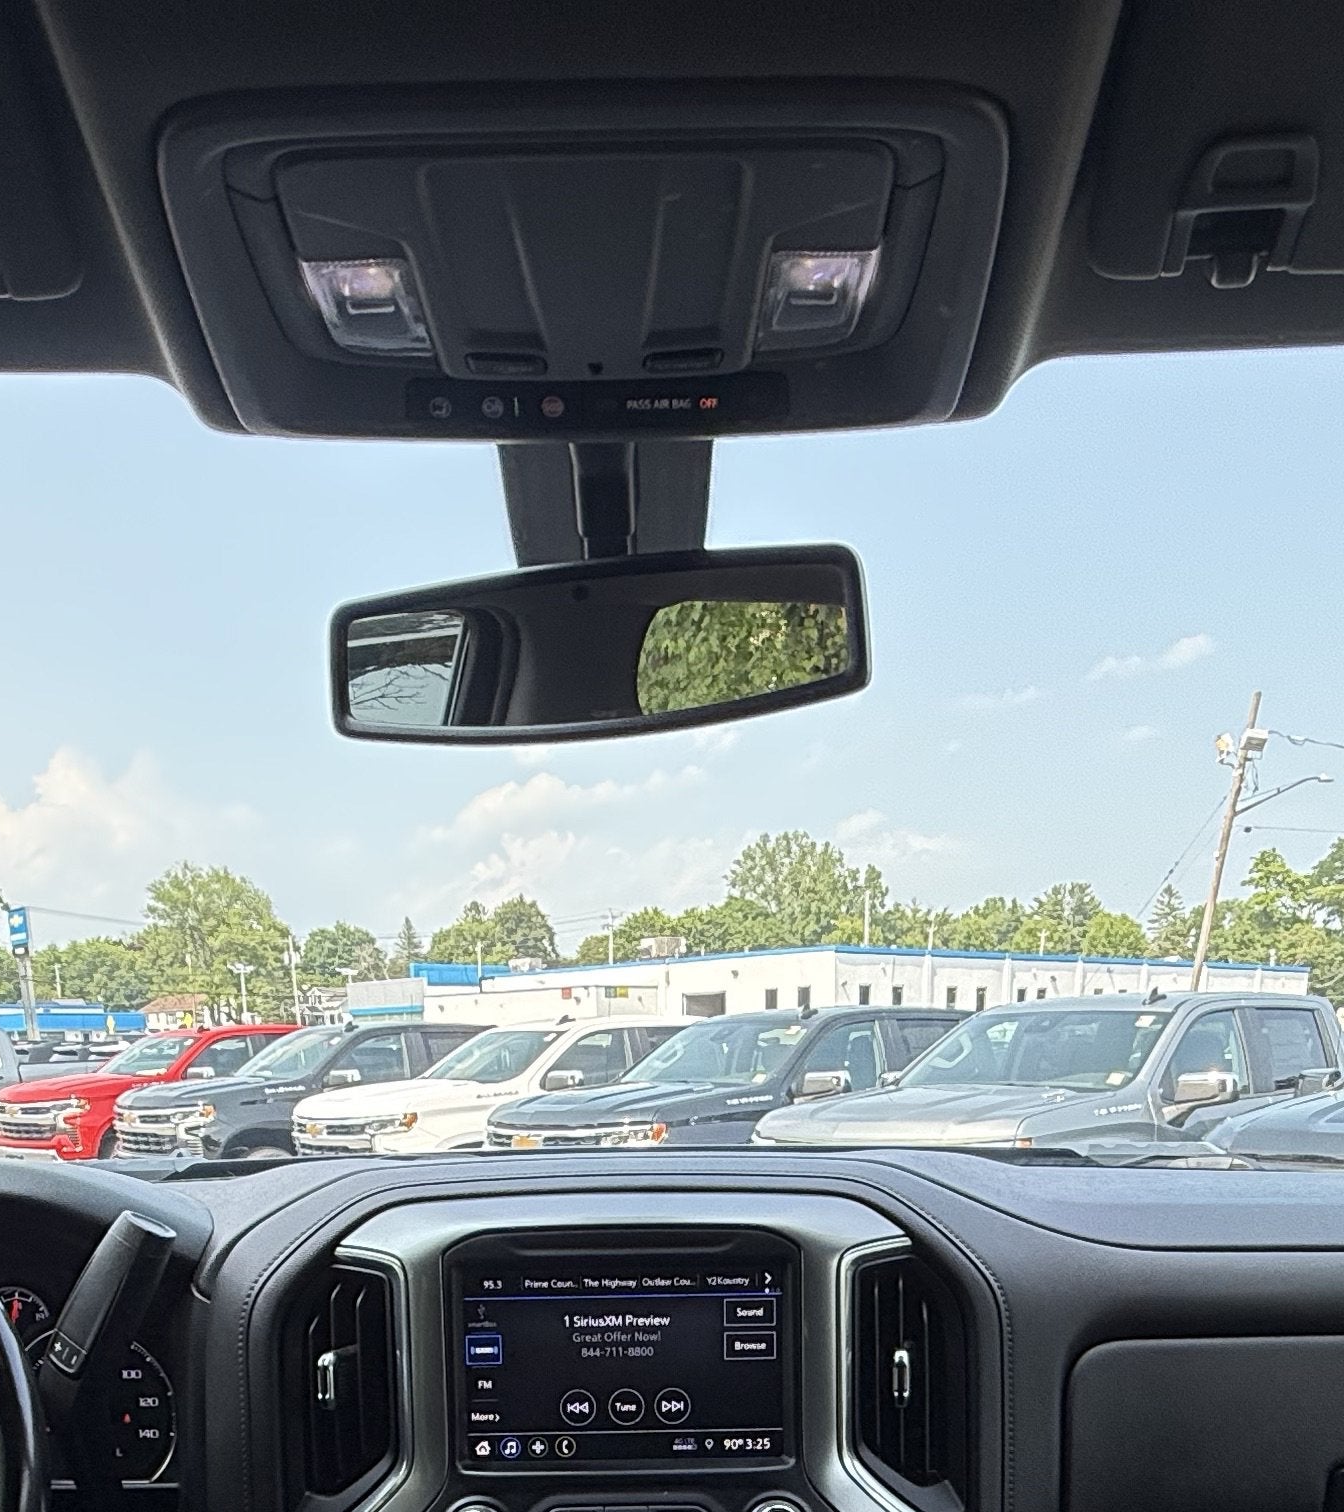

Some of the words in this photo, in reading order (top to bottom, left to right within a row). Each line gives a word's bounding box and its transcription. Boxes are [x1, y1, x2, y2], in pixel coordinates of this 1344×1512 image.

[626, 399, 651, 410] PASS
[653, 399, 670, 410] AIR
[671, 399, 691, 410] BAG
[700, 397, 718, 409] OFF
[483, 1280, 503, 1290] 95.3
[524, 1279, 549, 1289] Prime
[583, 1278, 600, 1288] The
[602, 1278, 637, 1290] Highway
[736, 1307, 764, 1318] Sound
[564, 1315, 570, 1328] 1
[573, 1314, 623, 1328] SiriusXM
[625, 1313, 671, 1327] Preview
[572, 1332, 602, 1343] Great
[604, 1331, 631, 1342] Offer
[634, 1330, 661, 1342] Now!
[734, 1341, 767, 1351] Browse
[581, 1346, 654, 1358] 844-711-8800
[121, 1369, 142, 1379] 100
[478, 1380, 492, 1389] FM
[139, 1397, 159, 1407] 120
[615, 1402, 637, 1412] Tune
[471, 1412, 494, 1423] More
[139, 1429, 159, 1439] 140
[745, 1438, 771, 1450] 3:25
